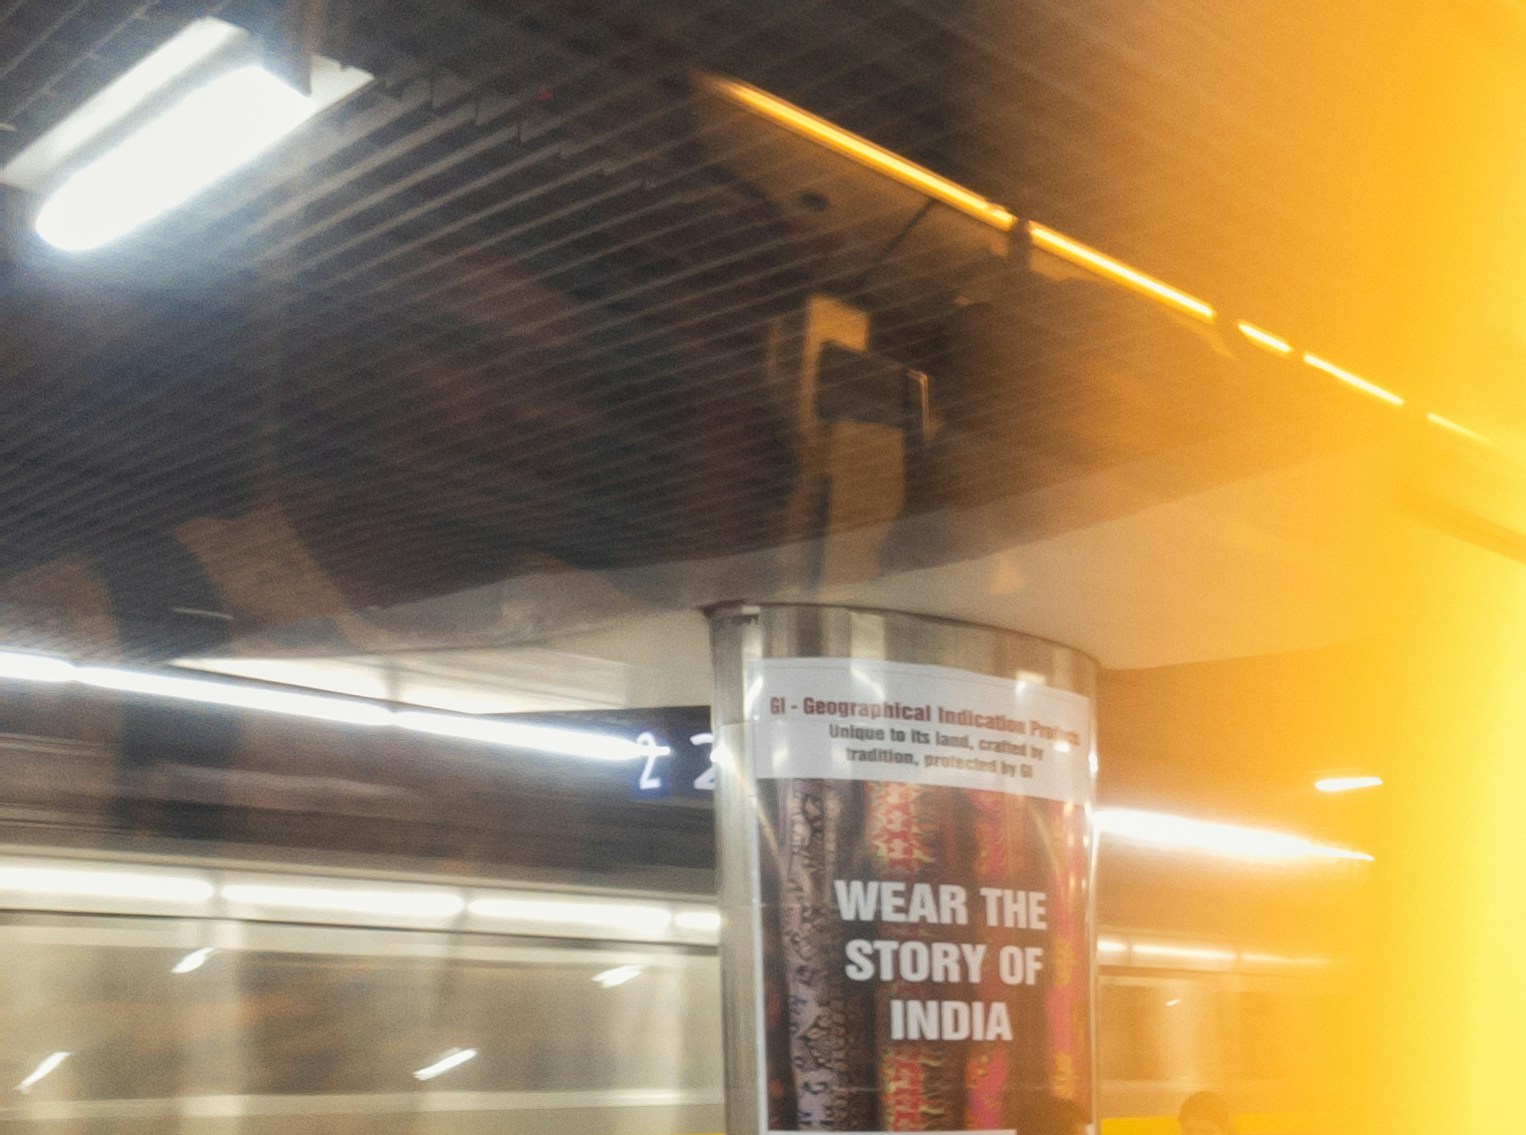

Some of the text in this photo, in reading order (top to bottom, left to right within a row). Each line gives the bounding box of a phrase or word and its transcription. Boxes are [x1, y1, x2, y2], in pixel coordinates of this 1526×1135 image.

[770, 697, 786, 715] GI
[803, 697, 931, 722] Geographical
[938, 706, 1026, 734] Indication
[637, 732, 661, 789] 2
[829, 724, 885, 742] Unique
[890, 728, 906, 743] to
[936, 732, 973, 750] land,
[979, 739, 1027, 757] crafted
[1030, 745, 1045, 762] by
[846, 747, 919, 766] tradition,
[924, 754, 997, 773] protected
[1001, 761, 1016, 778] by
[834, 879, 1047, 930] WEAR THE
[845, 939, 1043, 985] STORY OF
[890, 999, 1014, 1041] INDIA
